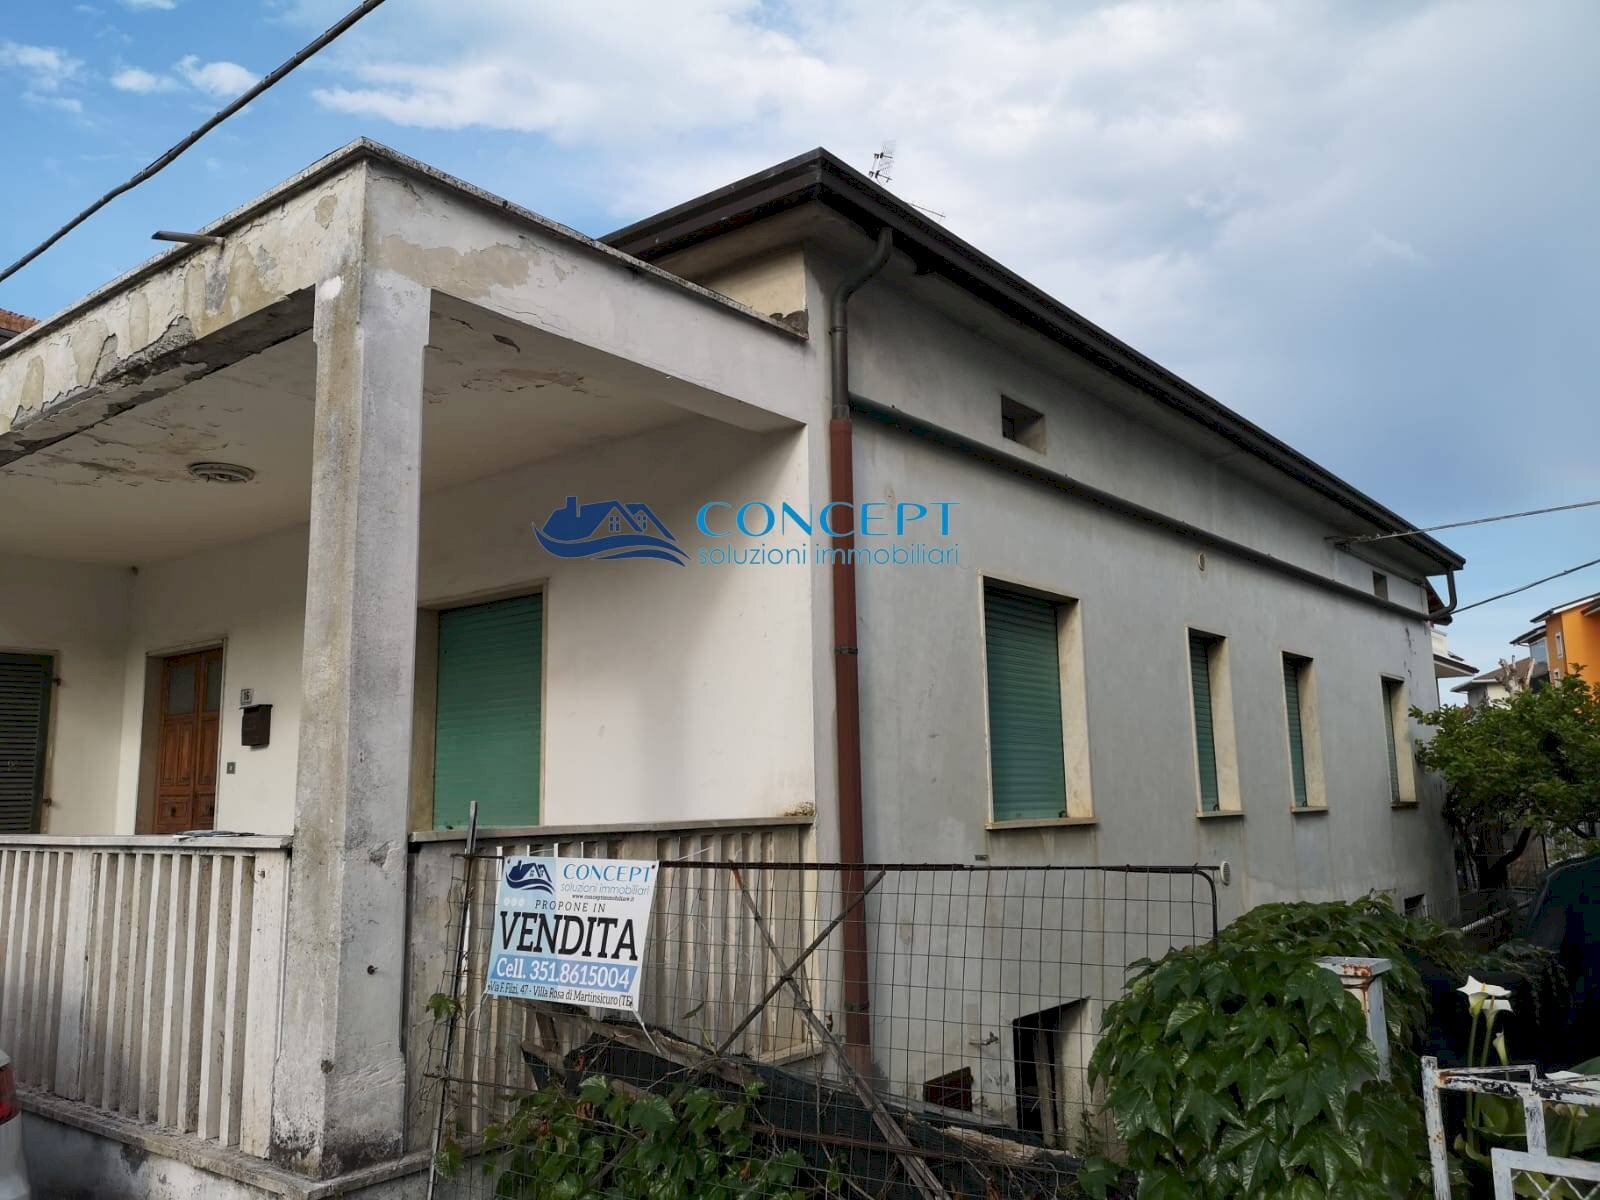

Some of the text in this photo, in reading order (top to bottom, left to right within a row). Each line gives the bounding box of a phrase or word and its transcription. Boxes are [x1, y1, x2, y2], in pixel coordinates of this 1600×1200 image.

[563, 863, 650, 883] CONCEPT
[560, 881, 650, 896] soluzioni immobiliari
[535, 899, 606, 913] PROPONE IN
[500, 911, 638, 961] VENDITA
[497, 957, 630, 989] Cell. 351.8615004
[520, 984, 529, 993] 47
[533, 985, 548, 998] Villa
[549, 987, 565, 1000] Rosa
[565, 989, 573, 1001] di
[574, 990, 618, 1005] Martinsicuro
